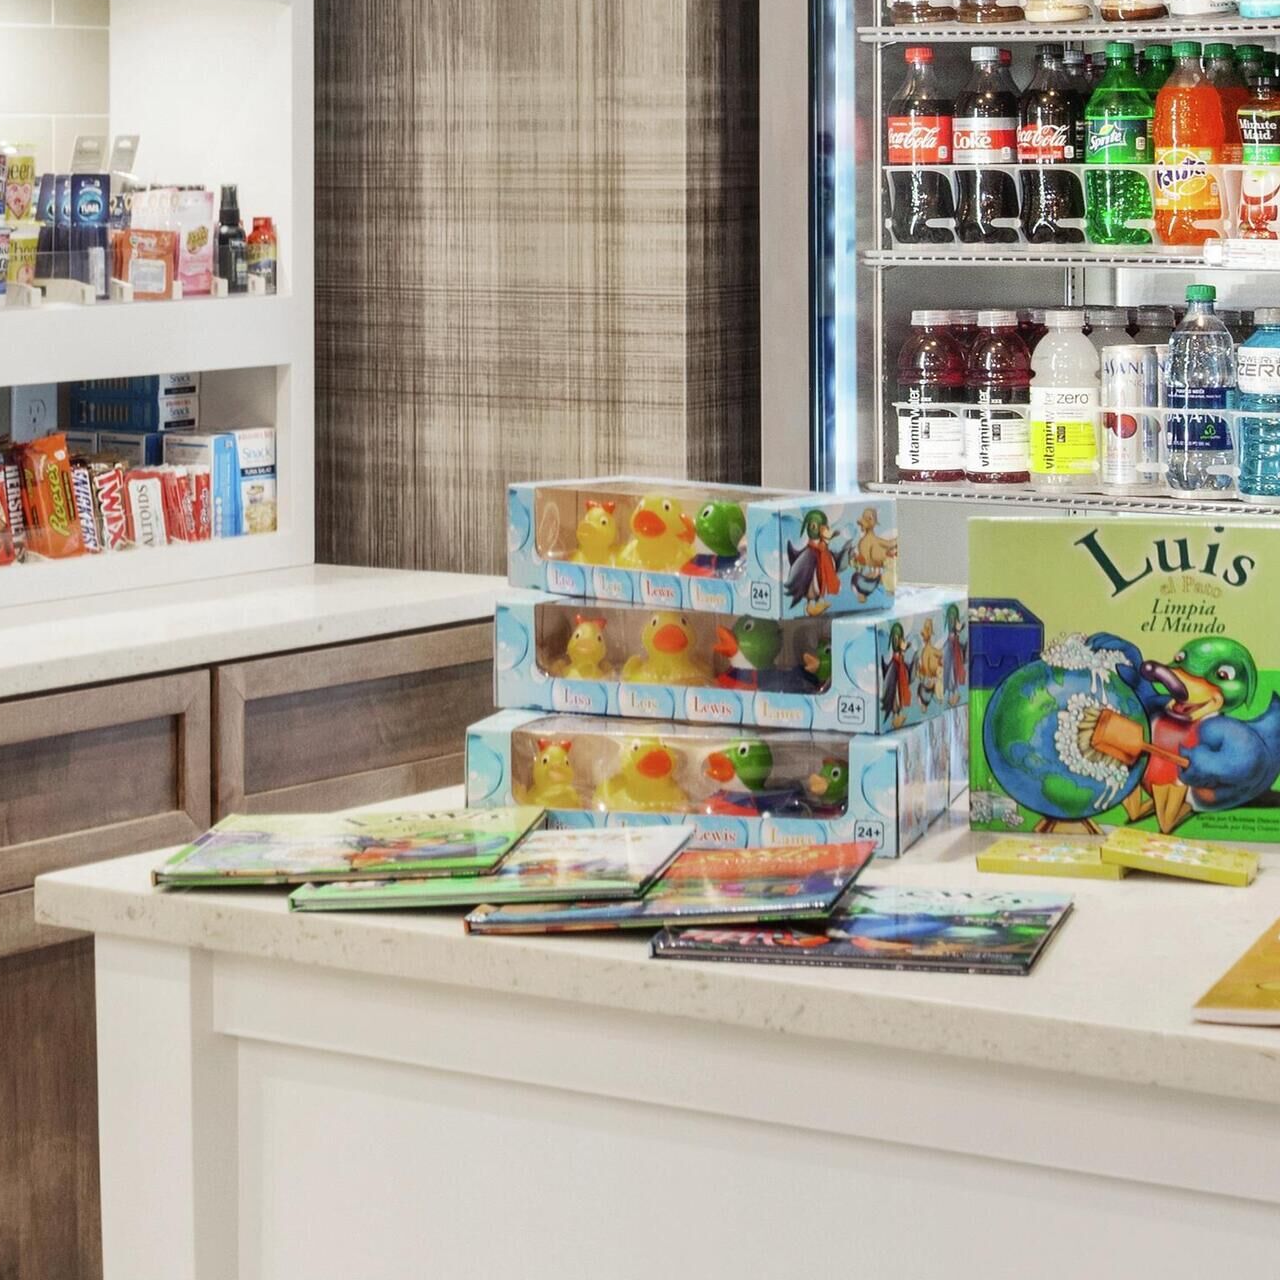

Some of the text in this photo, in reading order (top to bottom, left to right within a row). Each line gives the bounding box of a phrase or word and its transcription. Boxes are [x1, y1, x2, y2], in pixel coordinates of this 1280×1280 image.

[953, 131, 992, 149] Coke
[1090, 130, 1123, 151] Sprite
[1057, 392, 1089, 405] zero
[95, 467, 126, 550] TWIX
[1074, 525, 1256, 598] Luis
[646, 580, 675, 599] Lewis
[752, 587, 769, 600] 24+
[1181, 576, 1224, 599] Pato
[1151, 598, 1217, 617] Limpia
[1141, 616, 1227, 635] el Mundo
[693, 696, 733, 717] Lewis
[840, 702, 861, 714] 24+
[857, 826, 881, 839] 24+
